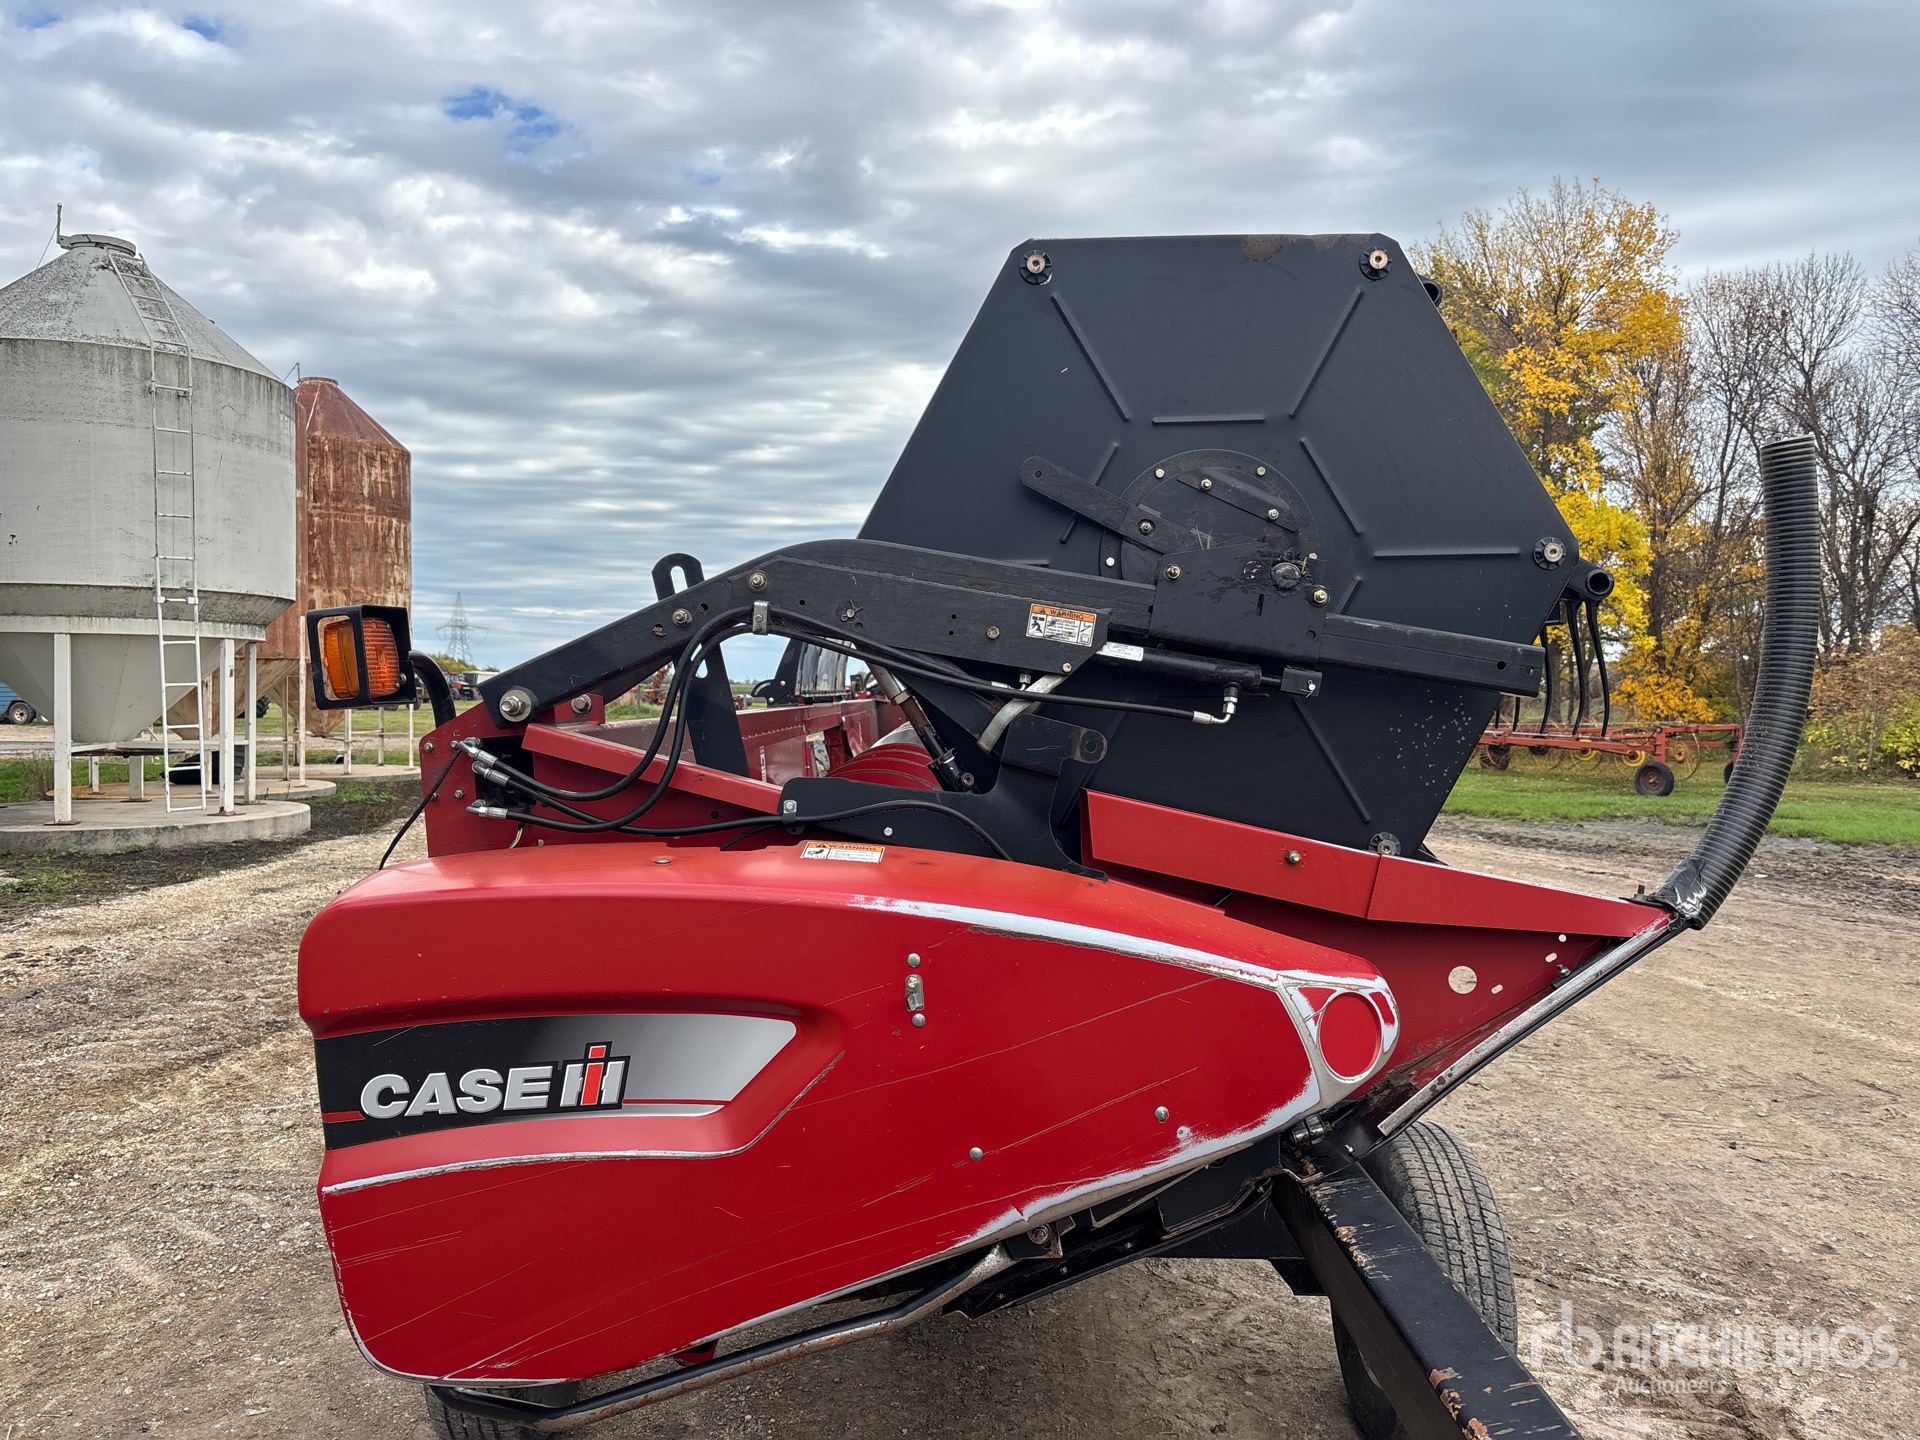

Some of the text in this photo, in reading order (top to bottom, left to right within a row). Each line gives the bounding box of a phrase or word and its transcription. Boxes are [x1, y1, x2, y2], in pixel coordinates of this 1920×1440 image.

[1050, 610, 1084, 620] WARNING
[829, 843, 878, 852] WARNING
[360, 1065, 554, 1119] CASE
